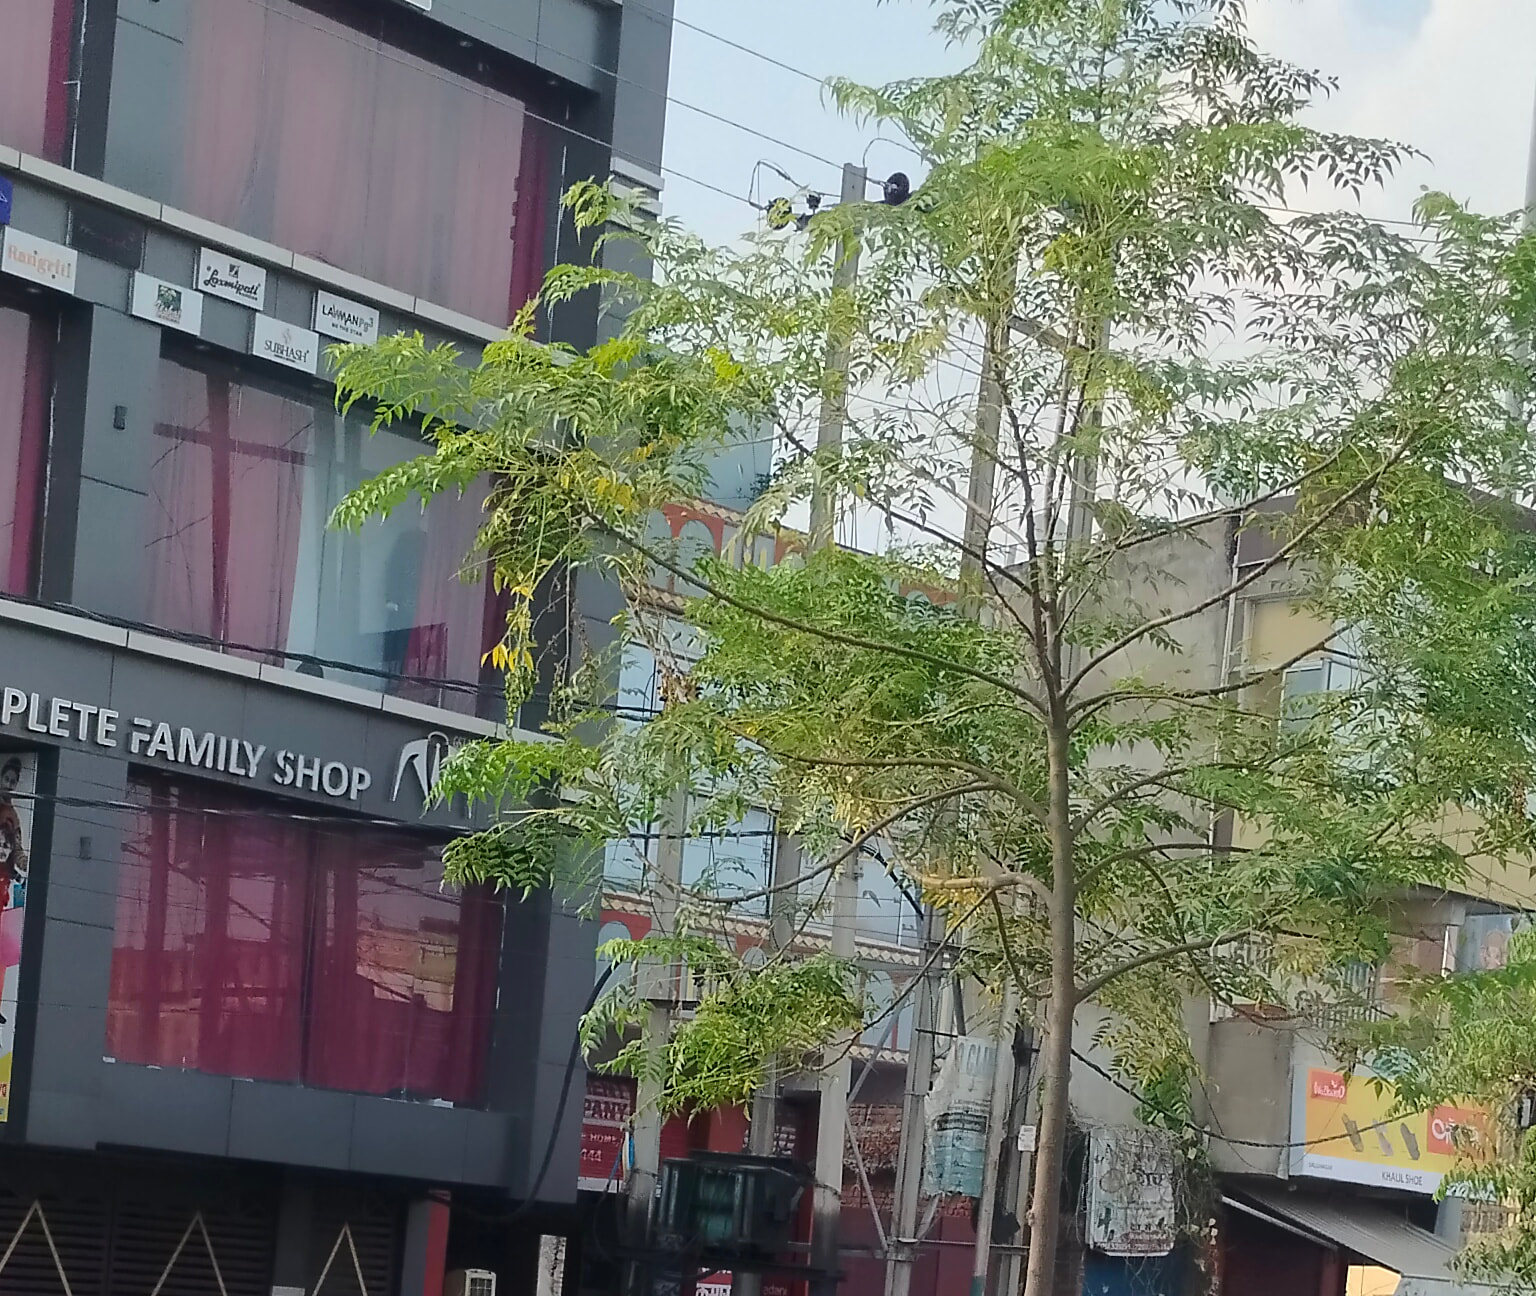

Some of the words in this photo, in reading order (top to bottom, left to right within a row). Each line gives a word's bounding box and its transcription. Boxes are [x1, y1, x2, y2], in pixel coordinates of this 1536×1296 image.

[265, 339, 306, 362] SUBHASH
[129, 716, 266, 779] FAMILY
[274, 748, 372, 800] SHOP
[1405, 1174, 1423, 1186] SHOE
